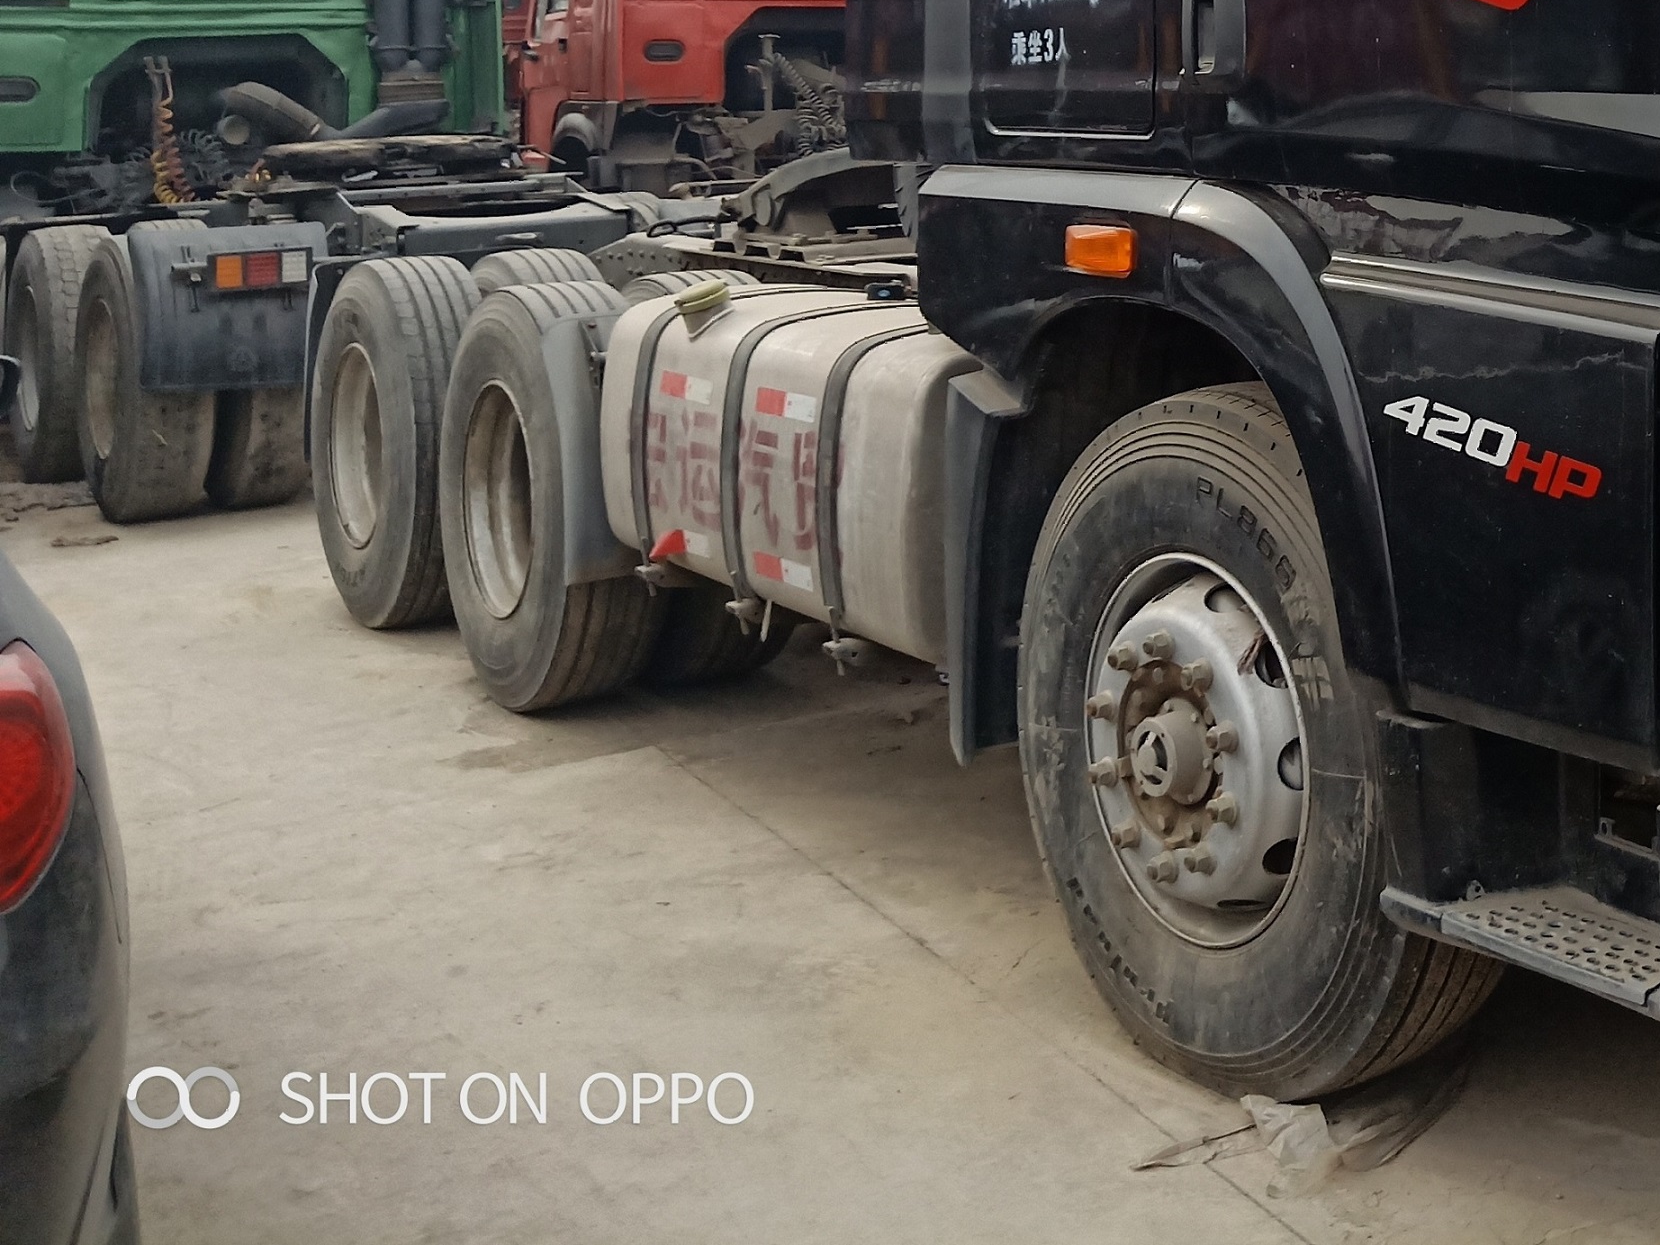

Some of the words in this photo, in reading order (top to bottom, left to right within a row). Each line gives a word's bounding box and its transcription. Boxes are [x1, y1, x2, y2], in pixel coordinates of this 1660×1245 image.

[1010, 27, 1071, 66] 乘坐3人
[1383, 396, 1602, 499] 420HP
